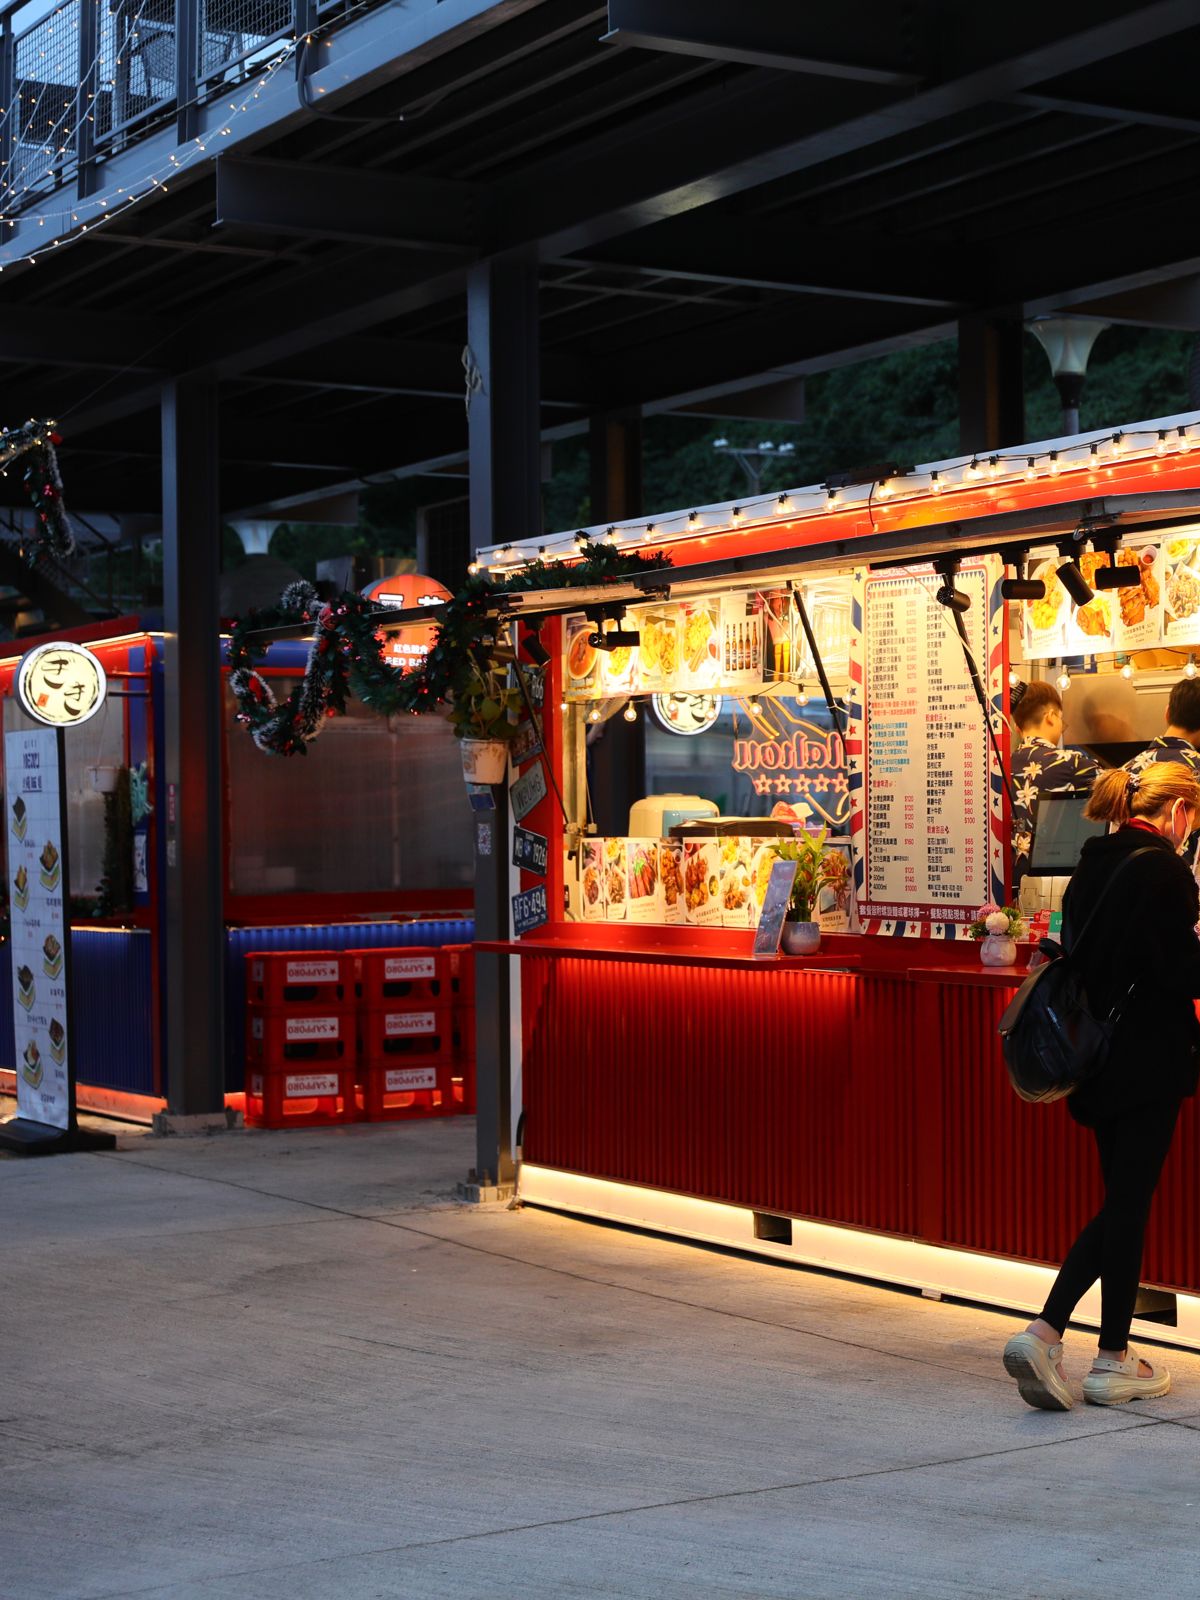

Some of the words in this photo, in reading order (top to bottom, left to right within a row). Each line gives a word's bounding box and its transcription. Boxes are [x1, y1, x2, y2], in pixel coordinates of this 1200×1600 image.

[964, 816, 976, 824] $100
[288, 967, 328, 977] SAPPORO
[386, 964, 425, 974] SAPPORO
[288, 1024, 328, 1034] SAPPORO
[387, 1019, 425, 1029] SAPPORO
[387, 1075, 426, 1086] SAPPORO
[288, 1081, 328, 1092] SAPPORO
